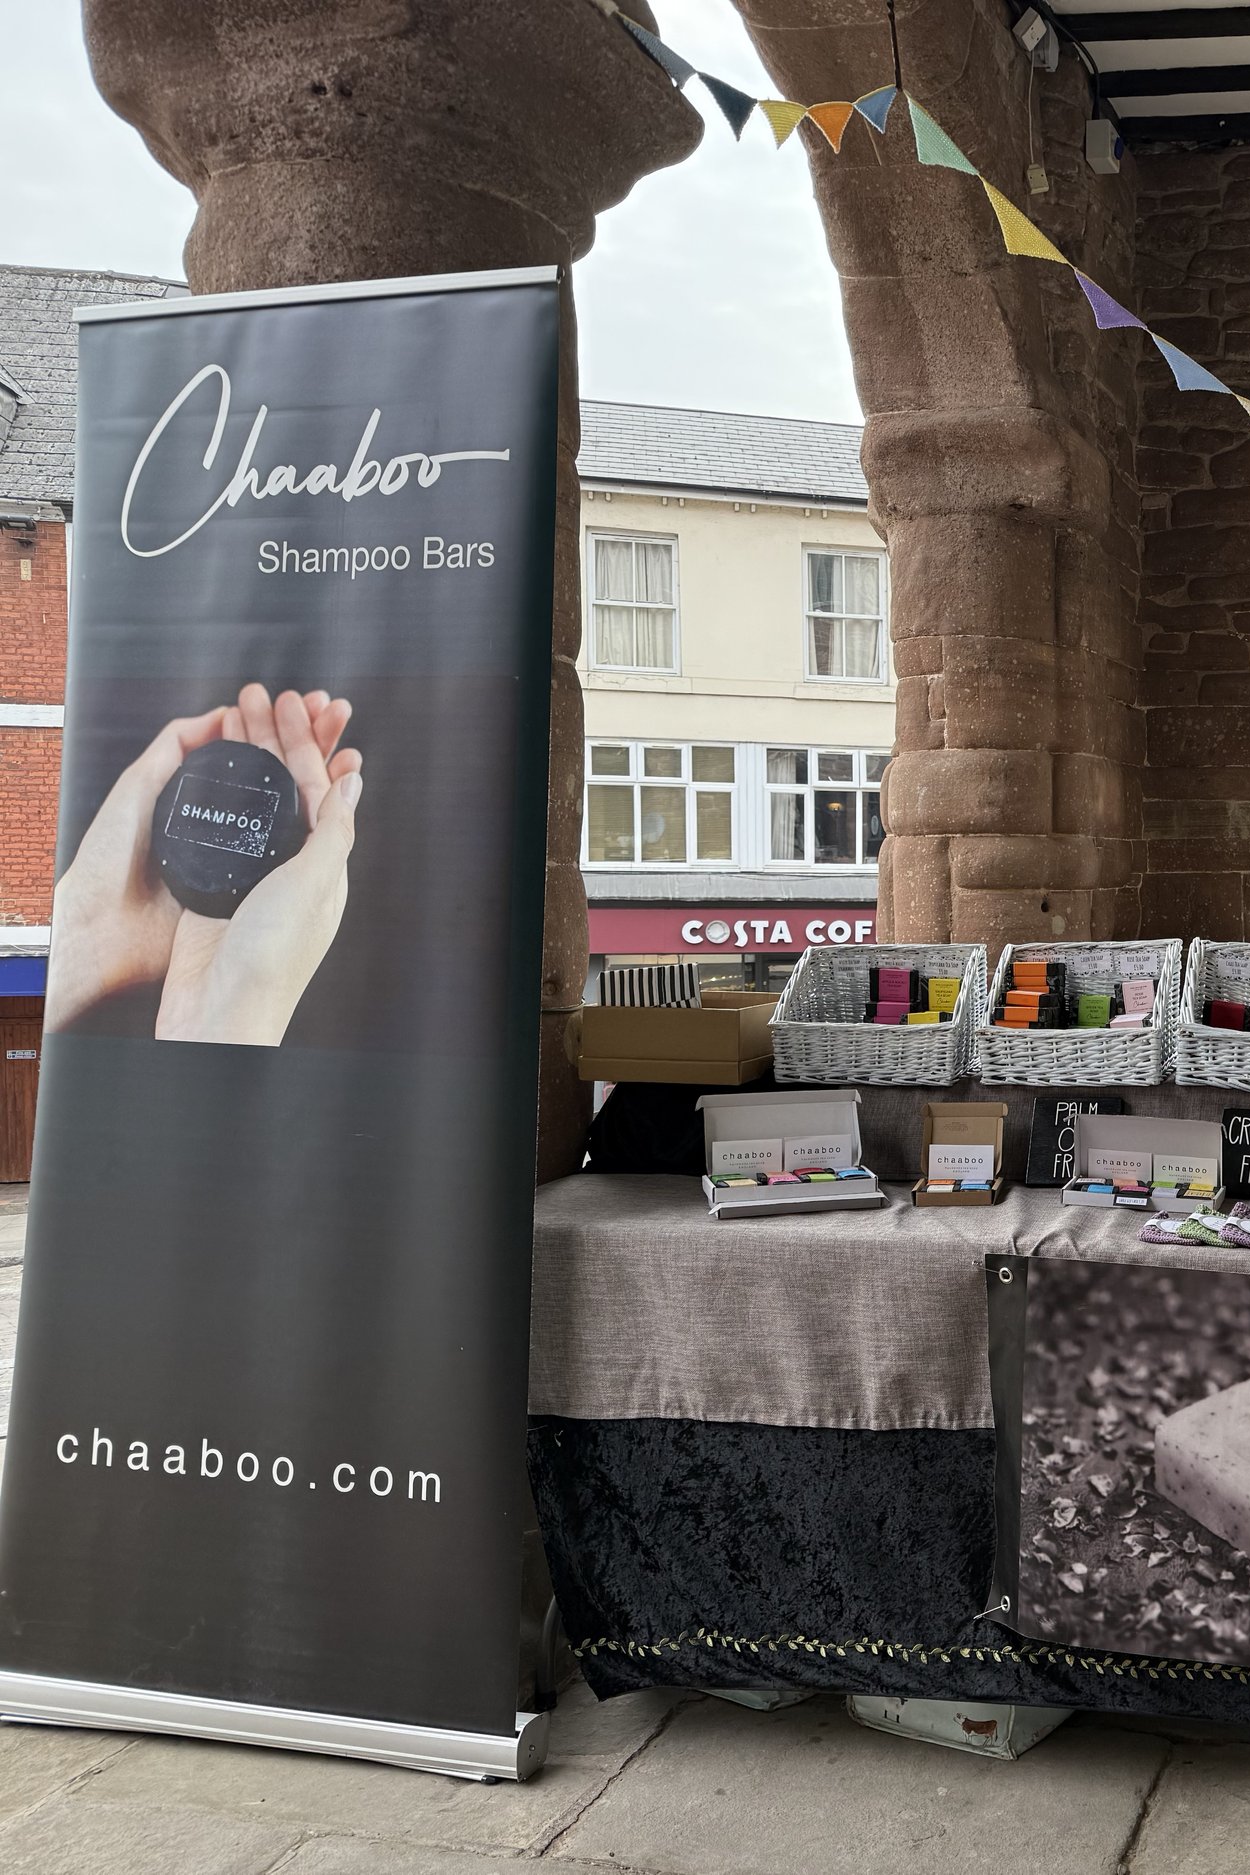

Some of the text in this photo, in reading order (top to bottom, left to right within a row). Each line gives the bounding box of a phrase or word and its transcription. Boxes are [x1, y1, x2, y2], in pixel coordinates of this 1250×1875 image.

[120, 364, 510, 557] Chaaboo
[258, 536, 495, 579] Shampoo Bars
[181, 804, 261, 831] SHAMPOO
[682, 920, 873, 947] COSTA COF
[722, 1151, 772, 1160] chaaboo
[793, 1146, 841, 1155] chaaboo
[1096, 1158, 1142, 1168] chaaboo
[1053, 1154, 1073, 1178] FR
[1162, 1164, 1208, 1174] chaaboo
[56, 1427, 441, 1503] chaaboo.com
